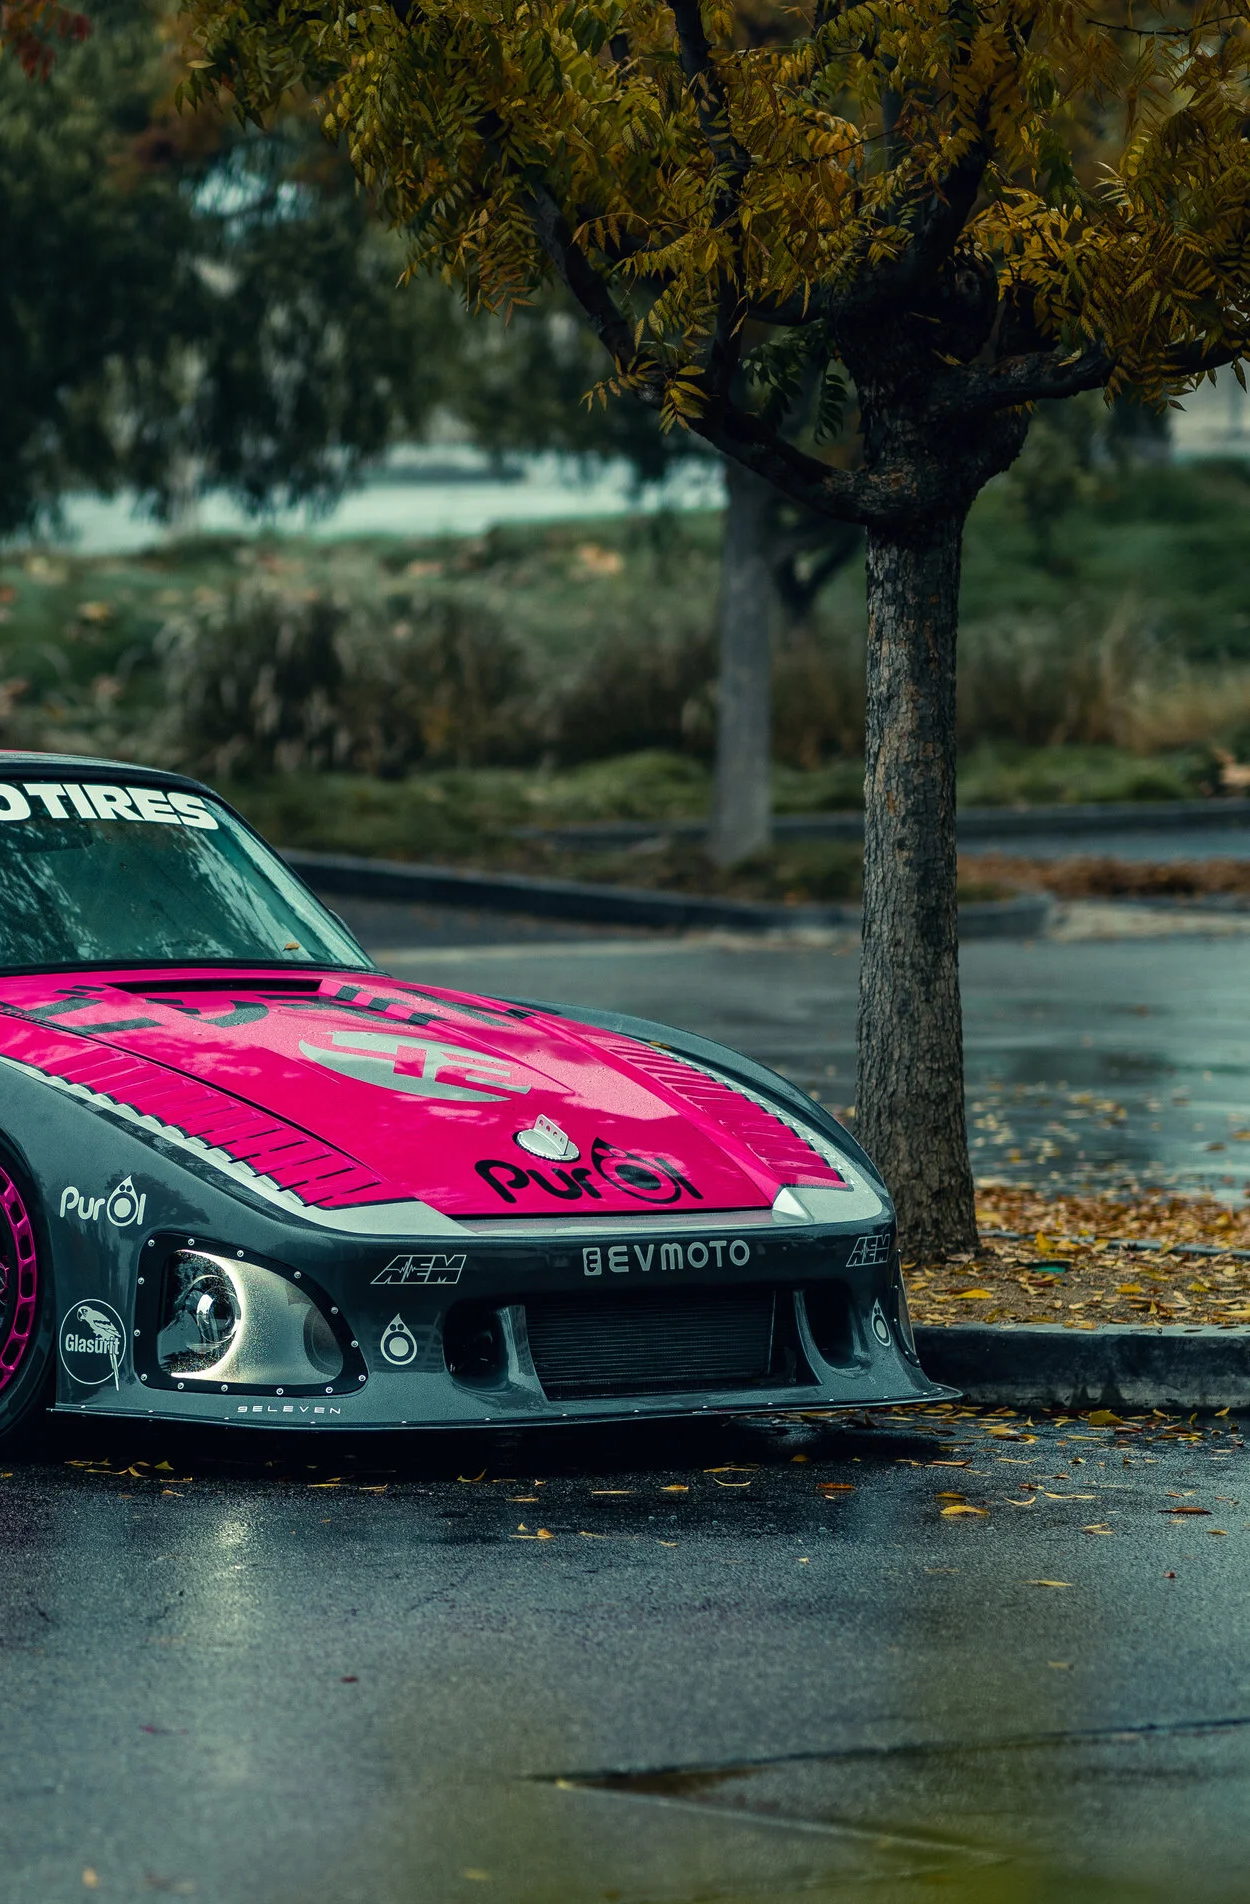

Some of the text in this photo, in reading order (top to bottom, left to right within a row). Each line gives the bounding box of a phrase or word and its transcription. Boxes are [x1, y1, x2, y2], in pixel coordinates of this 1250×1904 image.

[23, 783, 219, 831] TIRES
[65, 1333, 119, 1355] Glasurit
[237, 1405, 341, 1415] 9ELEVEN
